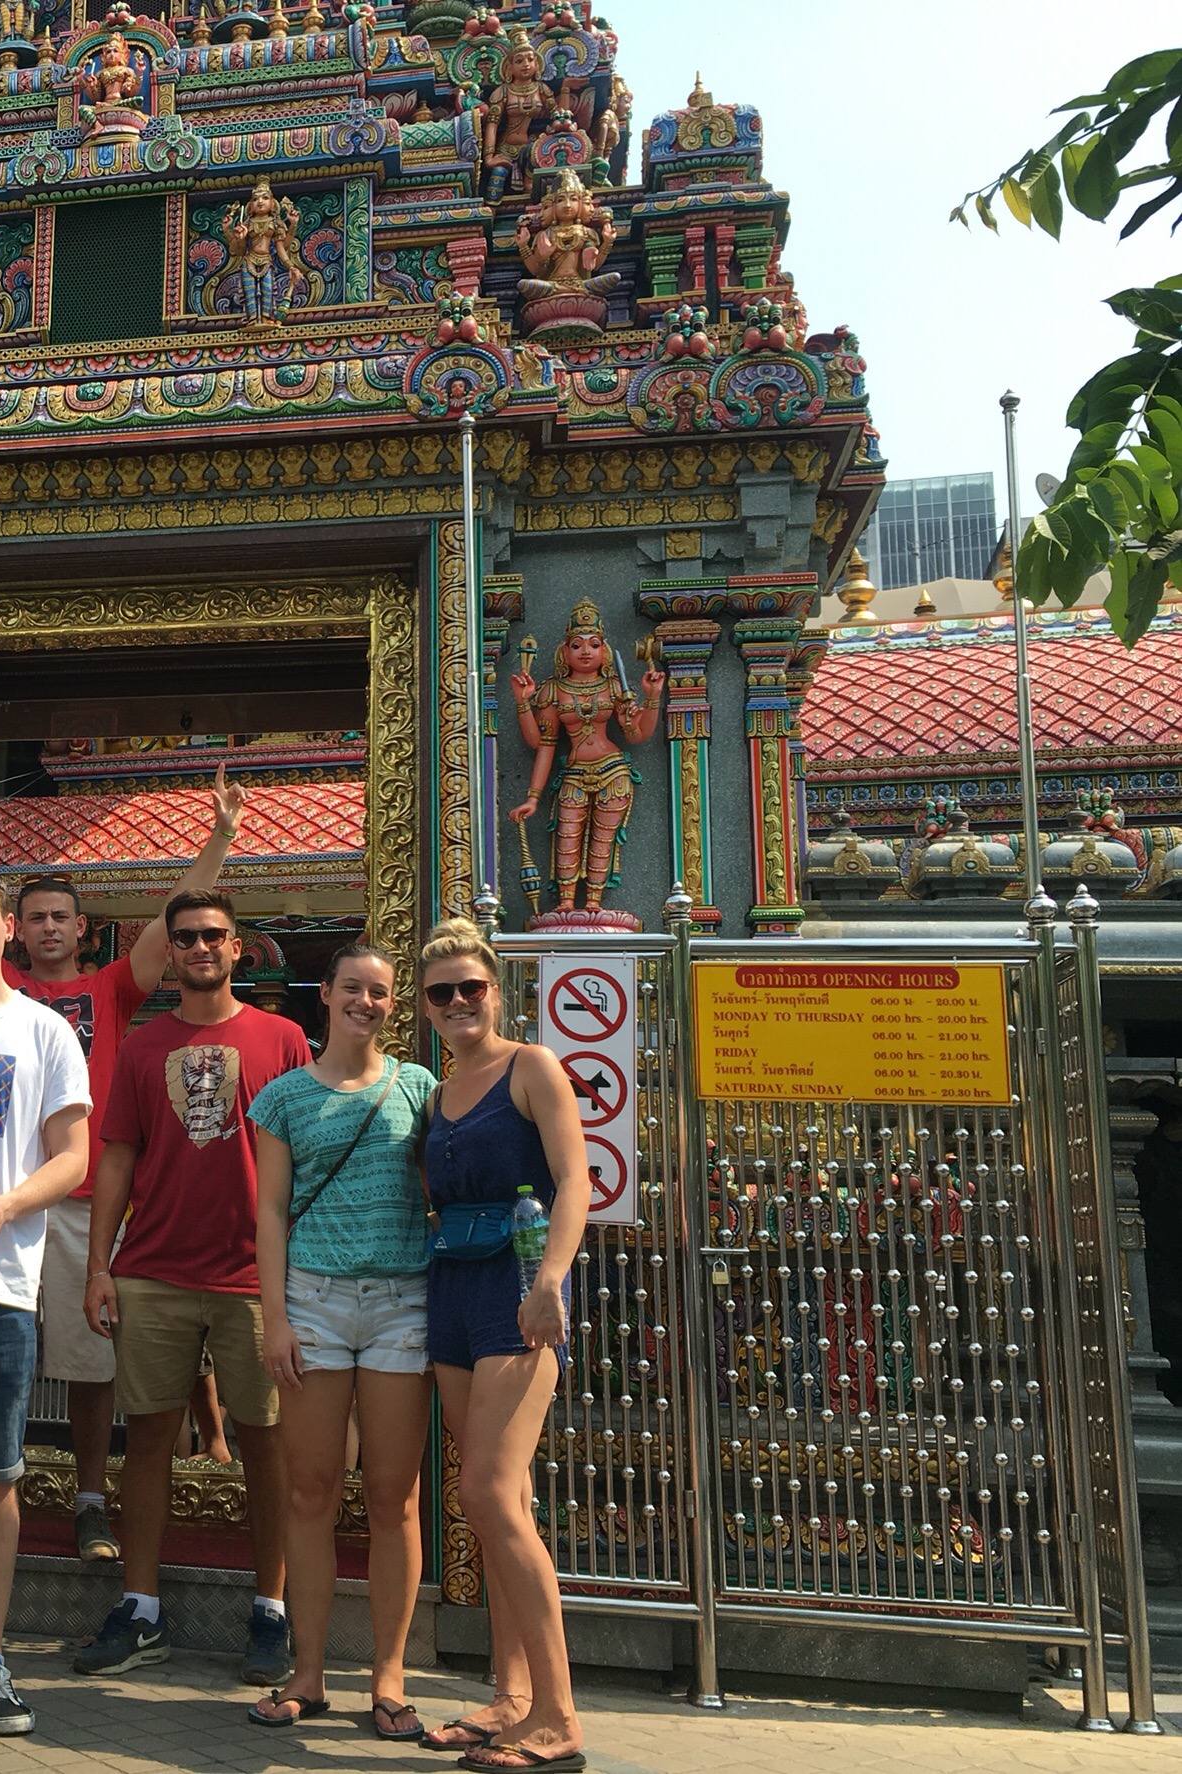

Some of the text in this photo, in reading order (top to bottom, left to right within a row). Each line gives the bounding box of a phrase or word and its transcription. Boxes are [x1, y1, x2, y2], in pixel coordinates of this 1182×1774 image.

[823, 974, 891, 985] OPENING
[900, 975, 953, 986] HOURS
[714, 1012, 768, 1021] MONDAY
[774, 1012, 791, 1021] TO
[796, 1013, 864, 1022] THURSDAY
[715, 1048, 757, 1057] FRIDAY
[792, 1085, 843, 1094] SUNDAY
